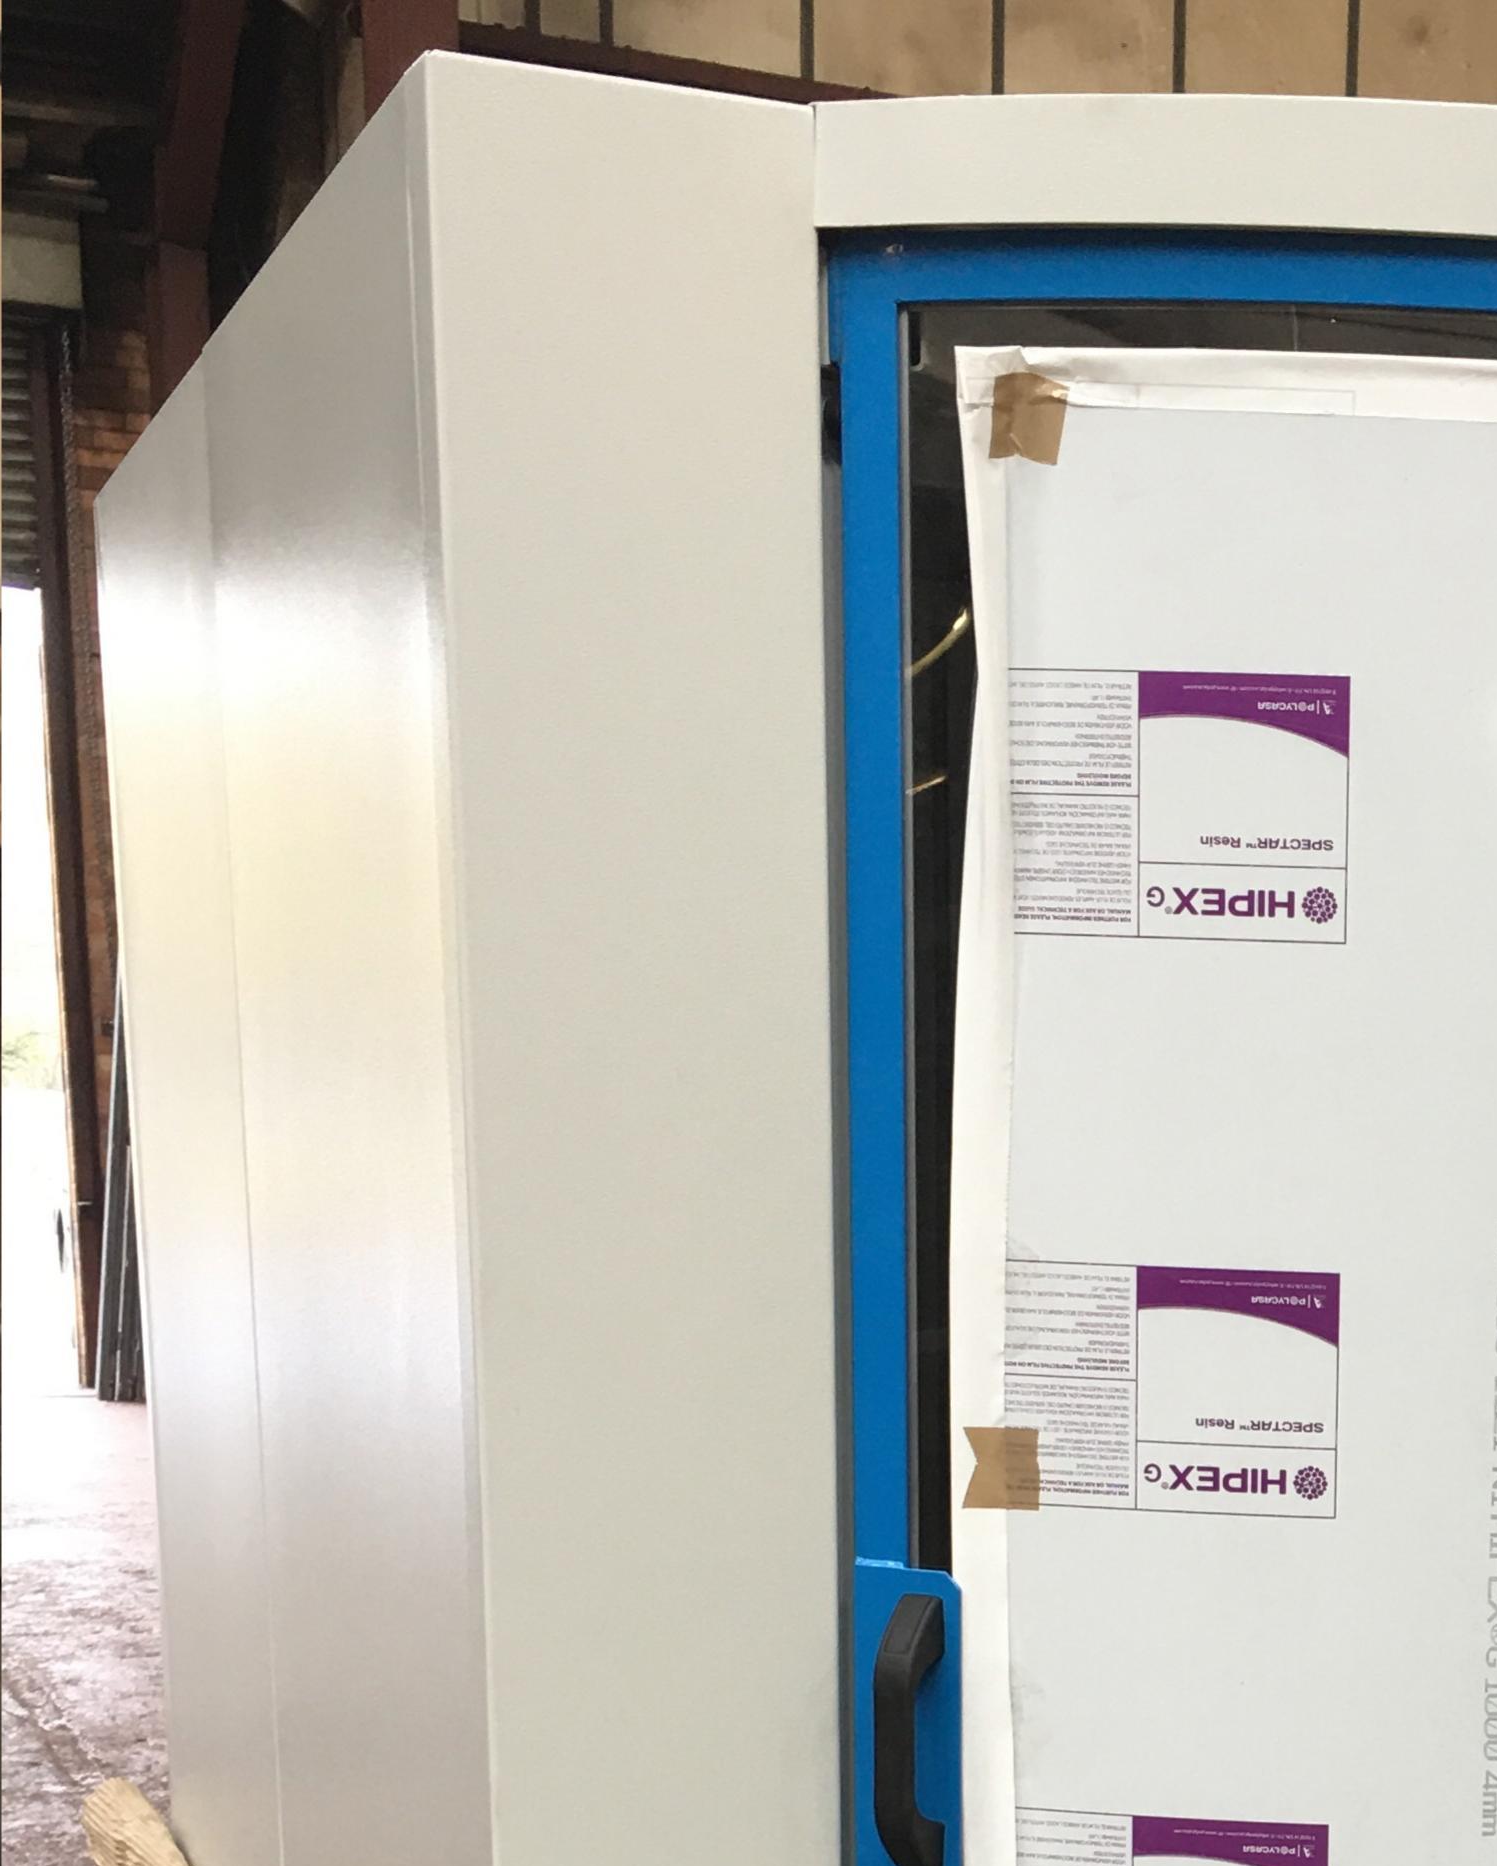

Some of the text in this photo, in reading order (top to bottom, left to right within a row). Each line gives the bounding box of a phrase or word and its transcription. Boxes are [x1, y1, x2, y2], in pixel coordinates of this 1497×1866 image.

[1200, 836, 1241, 848] Resin
[1146, 886, 1165, 907] G
[1196, 1418, 1235, 1430] Resin
[1144, 1463, 1161, 1482] G
